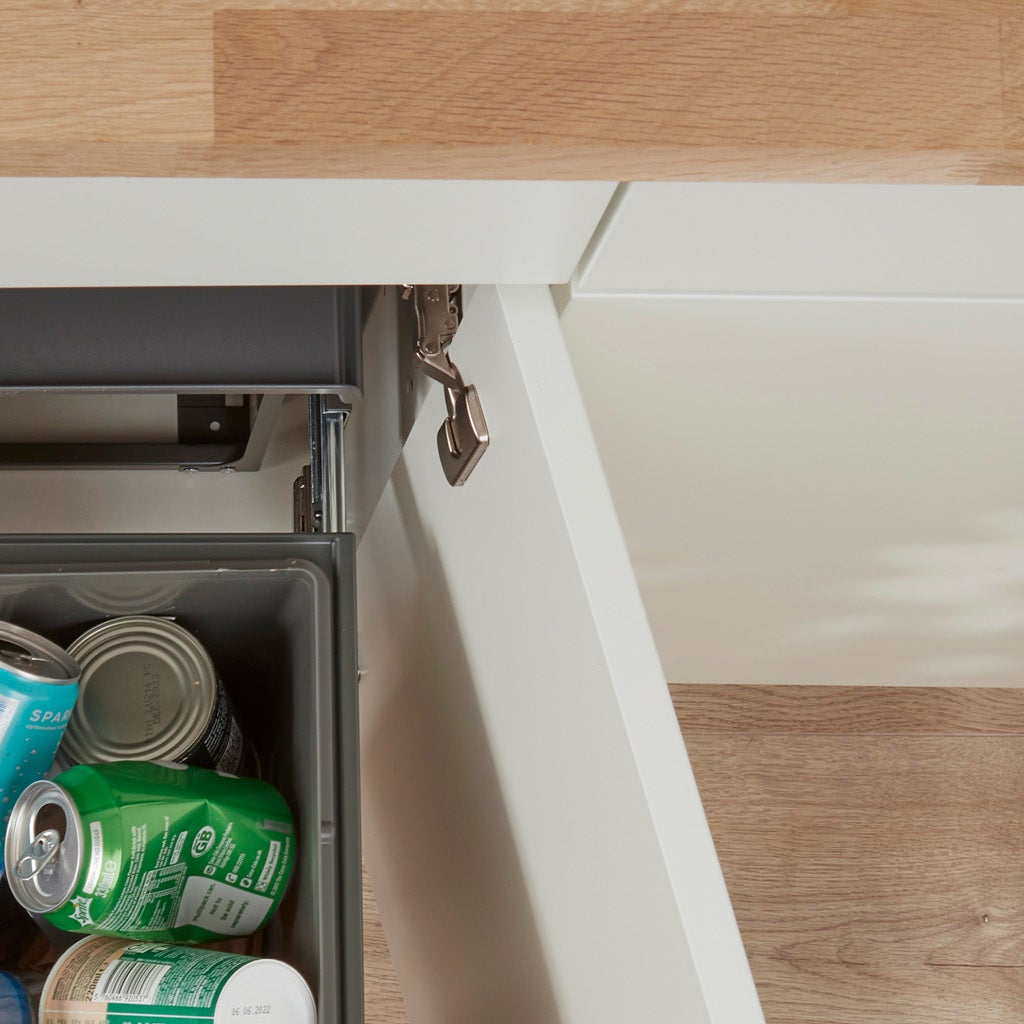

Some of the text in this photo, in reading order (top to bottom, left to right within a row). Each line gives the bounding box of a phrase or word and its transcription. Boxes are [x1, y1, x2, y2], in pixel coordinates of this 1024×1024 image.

[196, 830, 213, 853] GB
[74, 898, 87, 923] Sprite
[192, 895, 210, 921] Multipack
[209, 905, 218, 915] Not
[226, 900, 235, 912] sold
